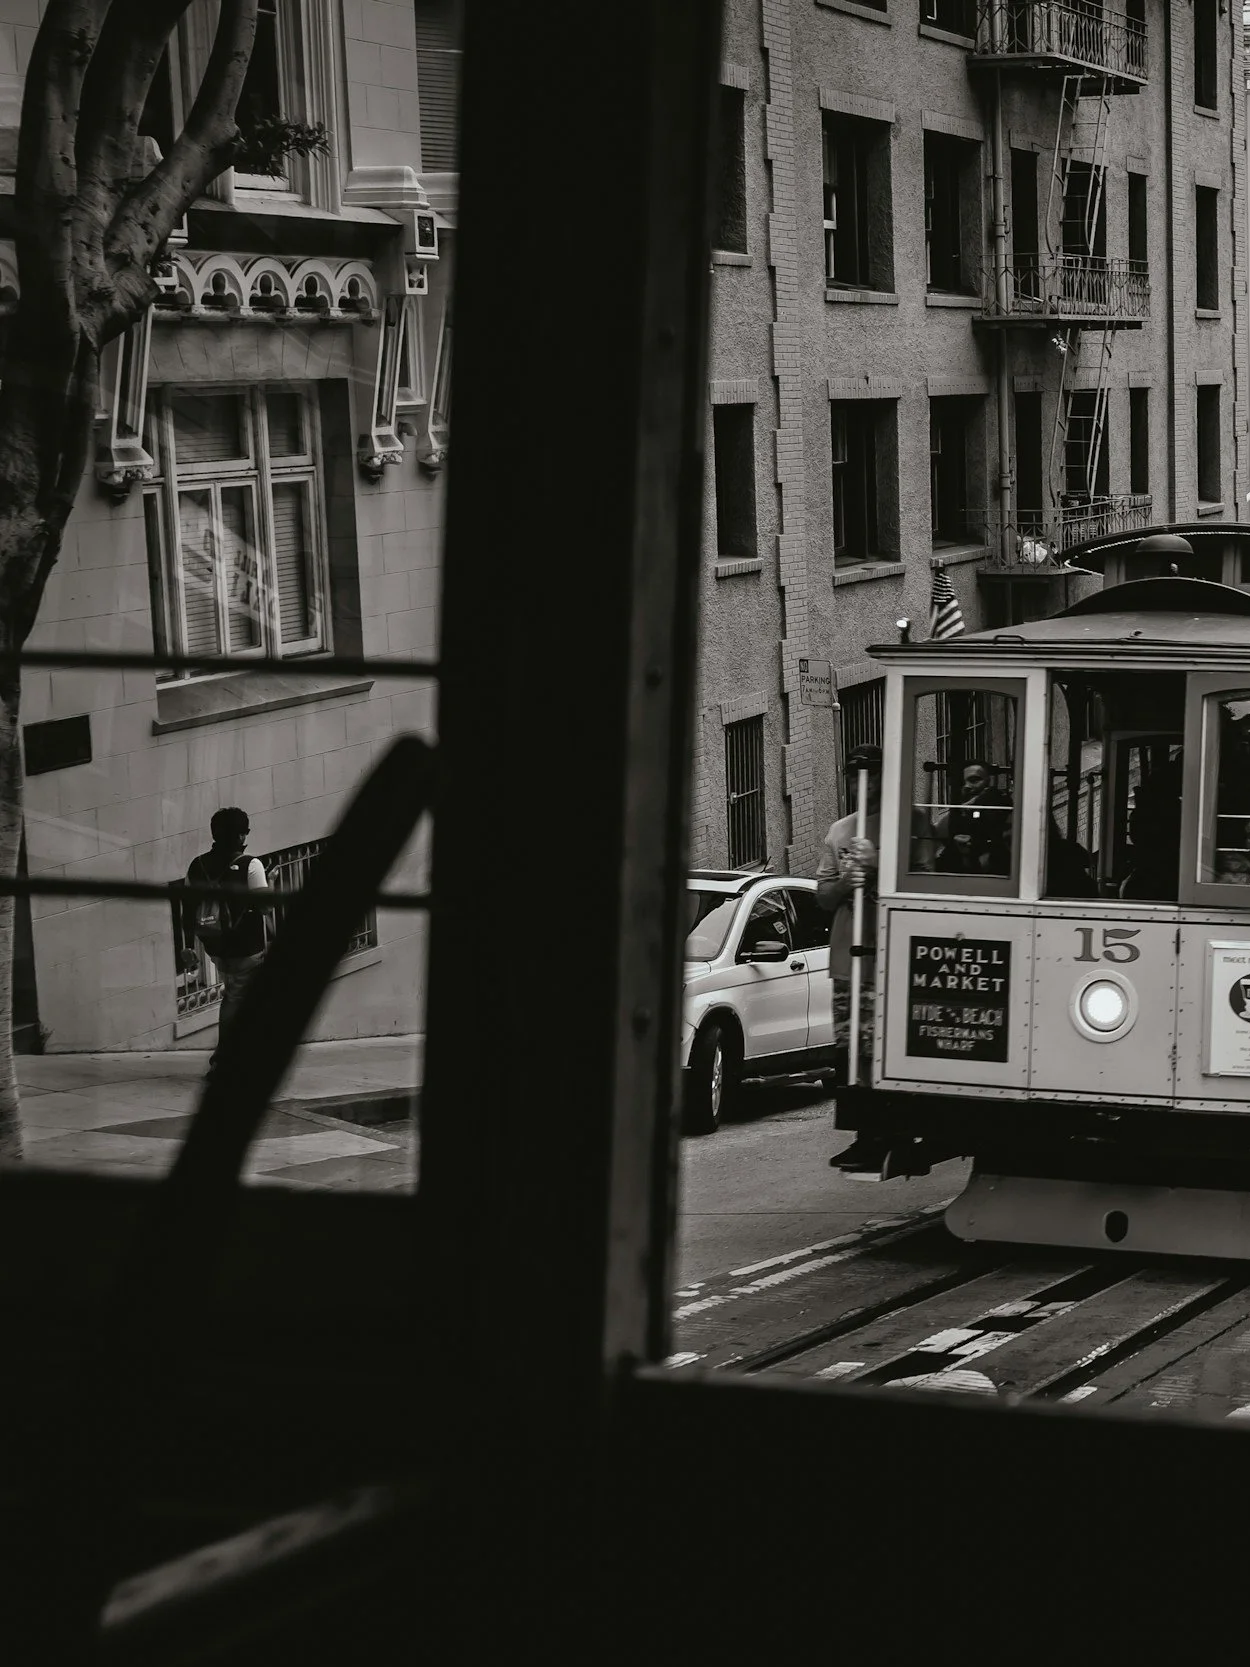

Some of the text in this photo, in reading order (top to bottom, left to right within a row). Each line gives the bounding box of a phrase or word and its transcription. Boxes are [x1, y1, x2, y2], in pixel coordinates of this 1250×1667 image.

[801, 675, 831, 685] PARKING
[1073, 927, 1142, 963] 15
[915, 946, 1004, 965] POWELL
[938, 963, 982, 975] AND
[913, 973, 1005, 992] MARKET
